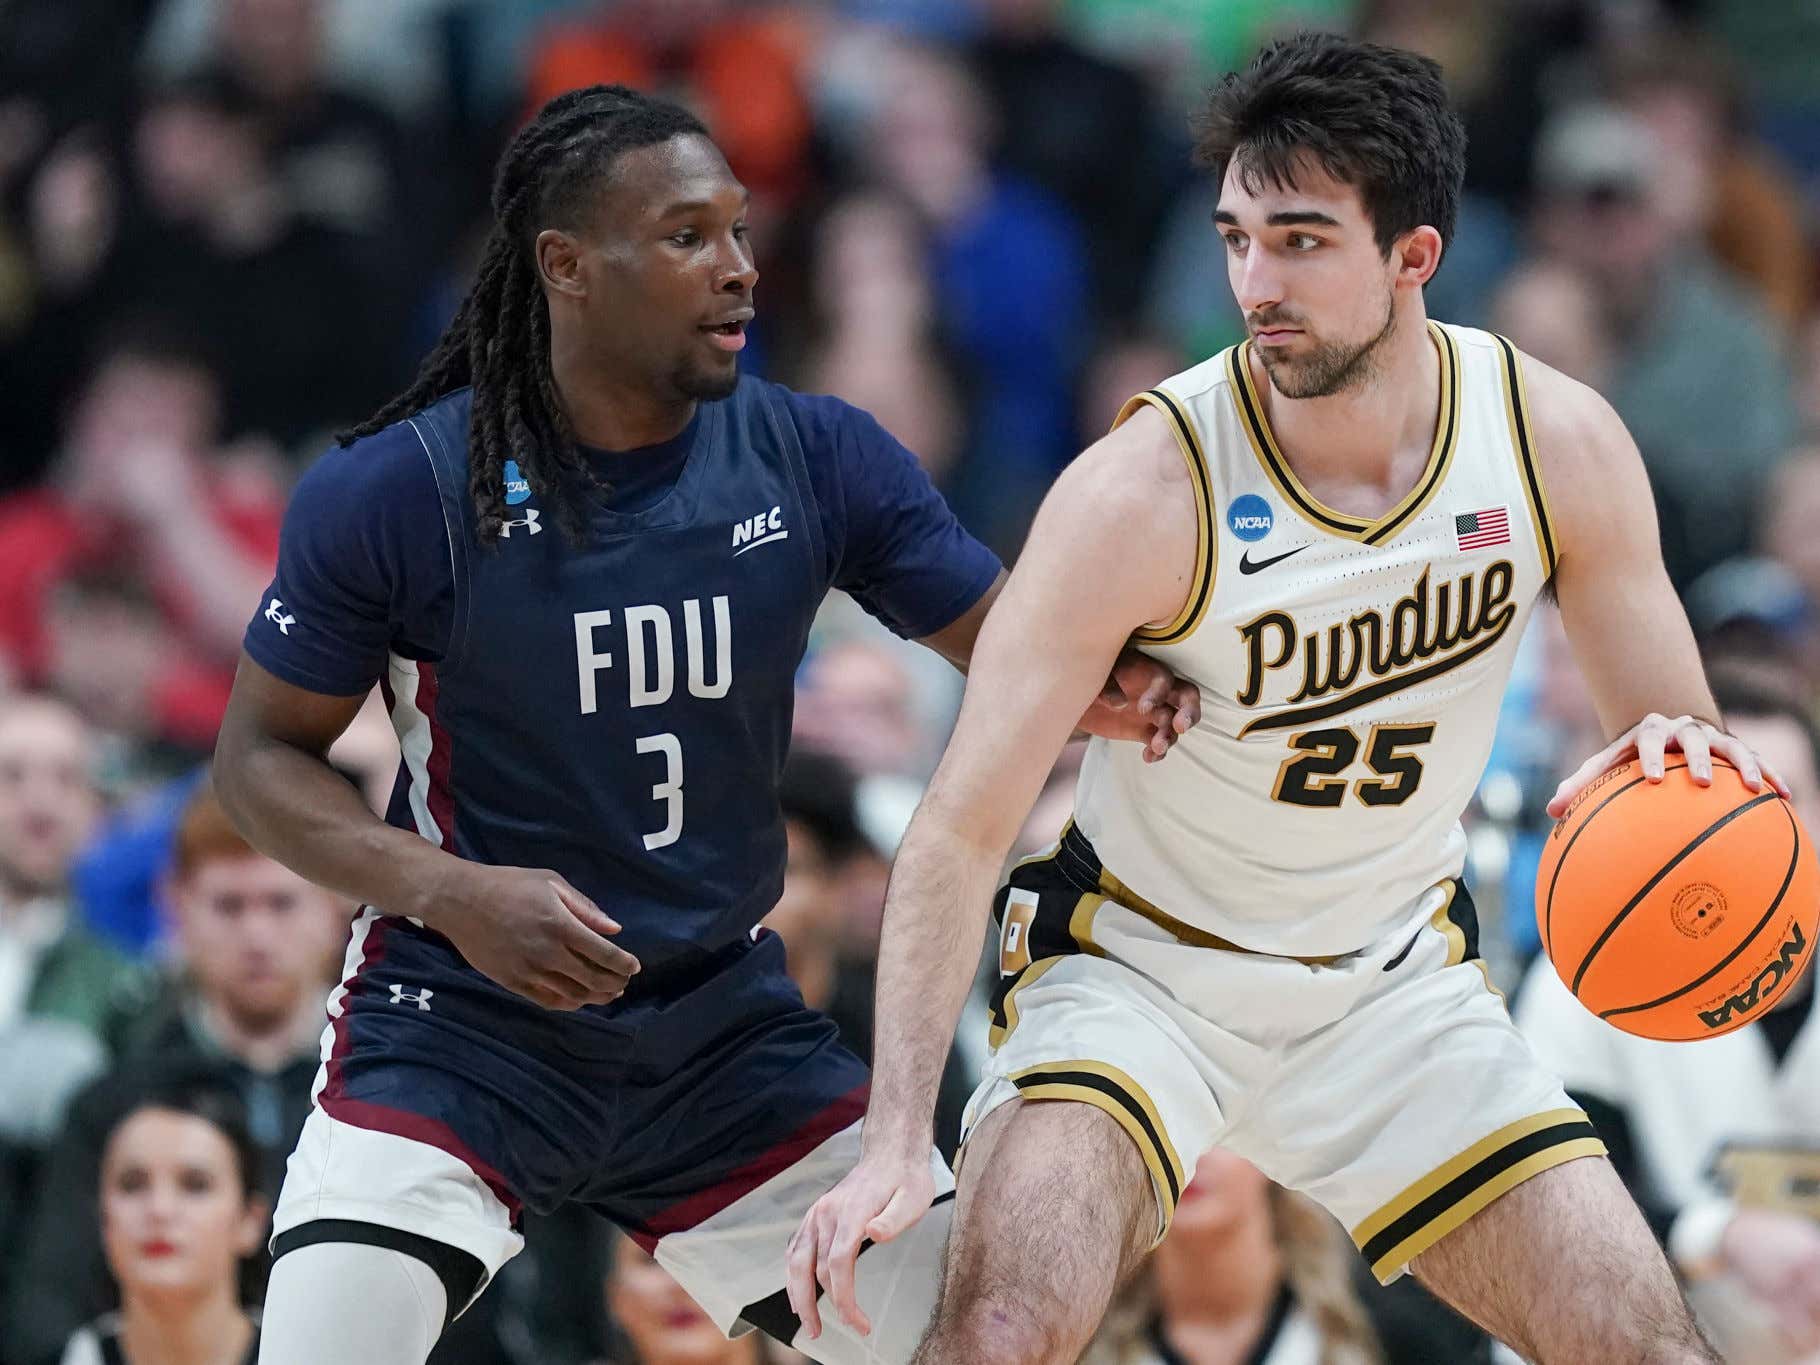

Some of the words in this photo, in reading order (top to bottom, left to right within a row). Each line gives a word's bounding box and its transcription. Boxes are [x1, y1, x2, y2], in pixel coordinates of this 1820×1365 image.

[503, 480, 530, 493] CAA
[732, 505, 782, 547] NEC
[1234, 516, 1271, 529] NCAA
[574, 595, 733, 715] FDU
[1236, 561, 1517, 706] Purdue
[635, 732, 684, 851] 3
[1271, 721, 1437, 809] 25
[1697, 920, 1807, 1029] NCAA
